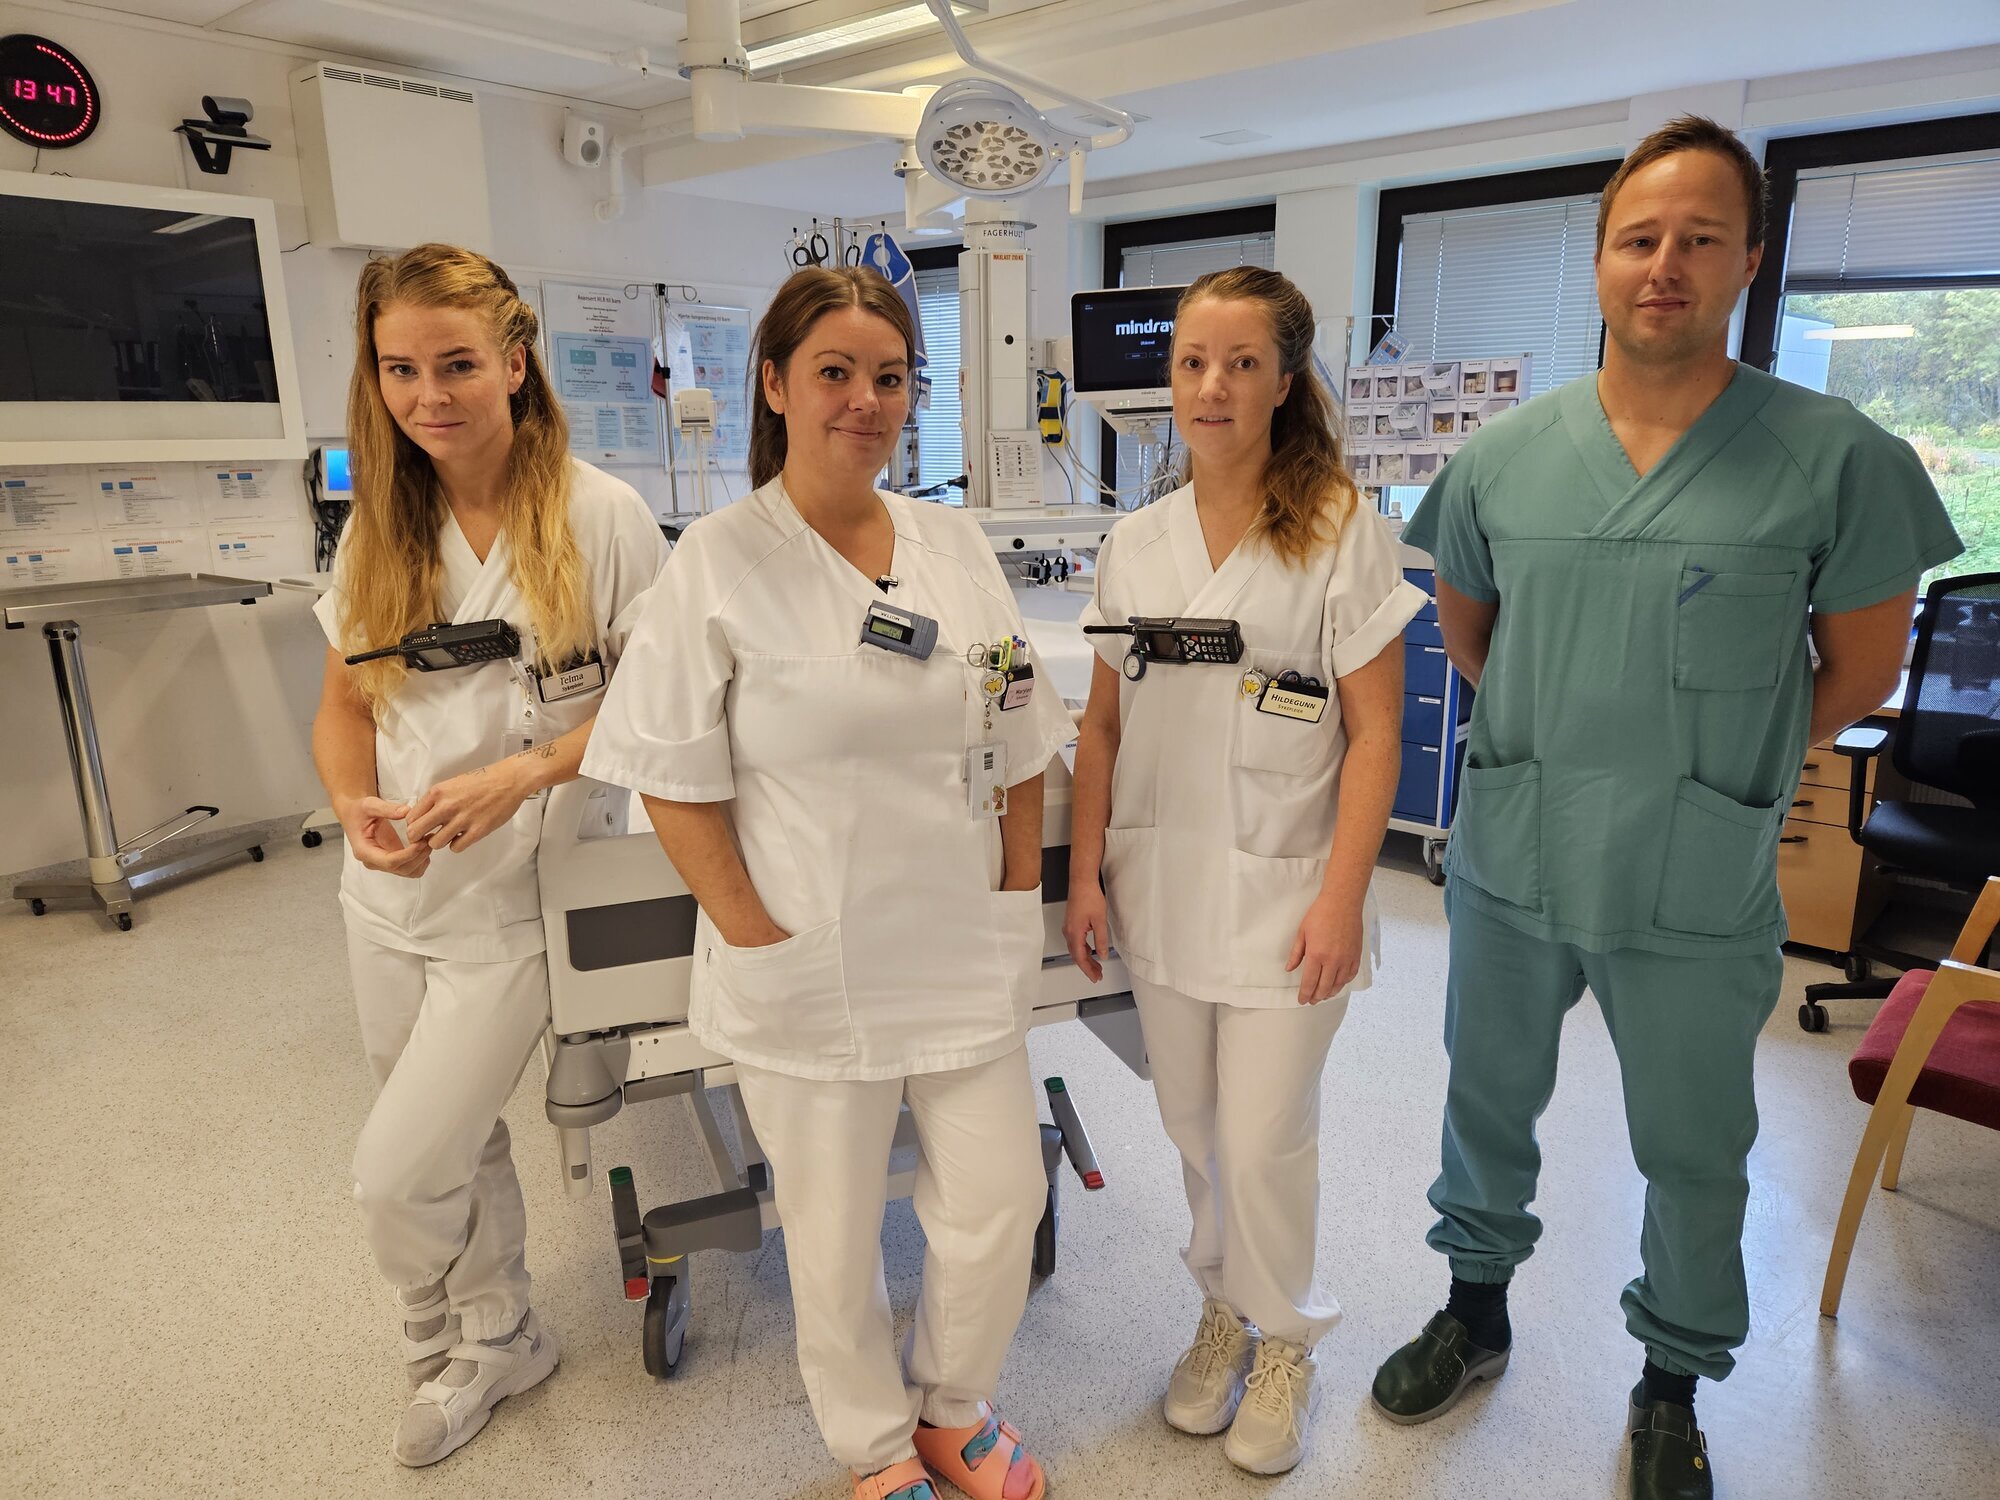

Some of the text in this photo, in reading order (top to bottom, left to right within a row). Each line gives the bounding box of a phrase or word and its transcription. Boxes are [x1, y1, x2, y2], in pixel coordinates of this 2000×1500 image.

[14, 79, 76, 106] 13 47
[983, 229, 1023, 238] FAGERHULT
[1115, 318, 1174, 336] mindray
[560, 673, 584, 686] Telma
[1271, 693, 1316, 710] HILDEGUNN
